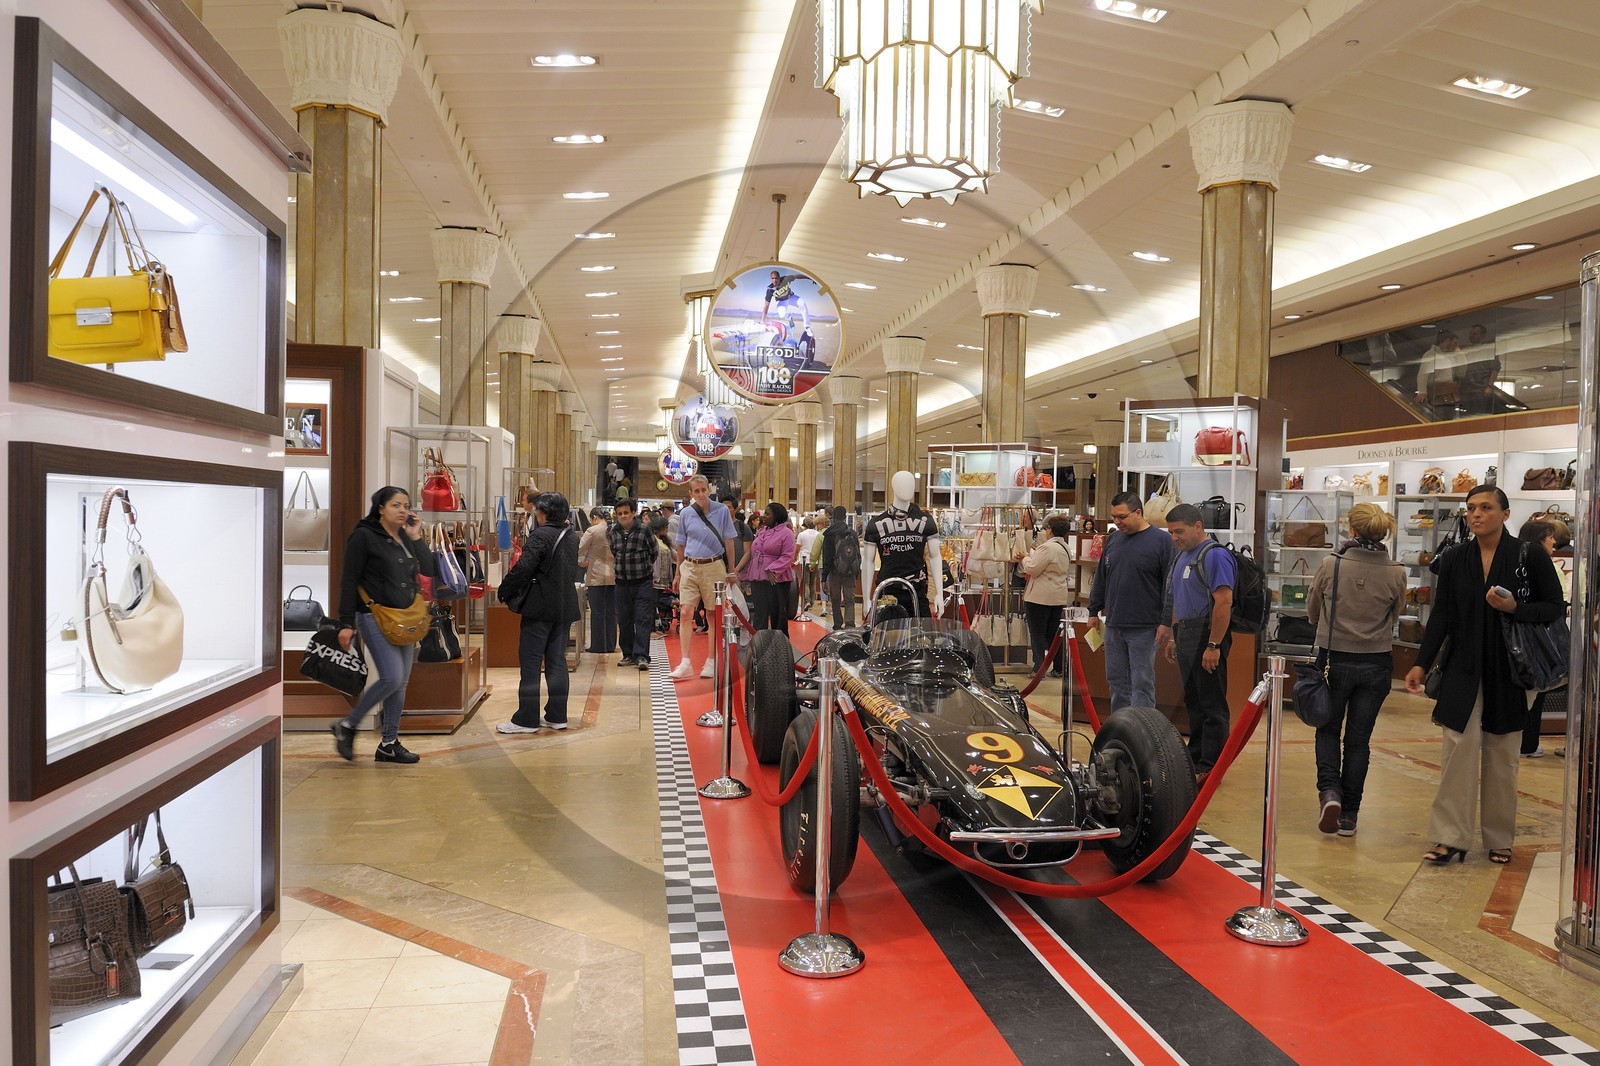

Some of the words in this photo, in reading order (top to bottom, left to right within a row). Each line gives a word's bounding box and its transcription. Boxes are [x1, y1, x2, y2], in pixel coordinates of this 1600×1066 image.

[759, 347, 793, 358] IZOD
[759, 366, 791, 385] 100
[698, 443, 714, 452] 100
[1357, 450, 1388, 460] DOONEY
[1395, 446, 1428, 457] BOURKE
[875, 516, 928, 538] novi
[880, 535, 905, 545] GROOVED
[890, 544, 915, 552] SPECIAL
[305, 640, 368, 676] EXPRESS
[965, 732, 1025, 764] 9
